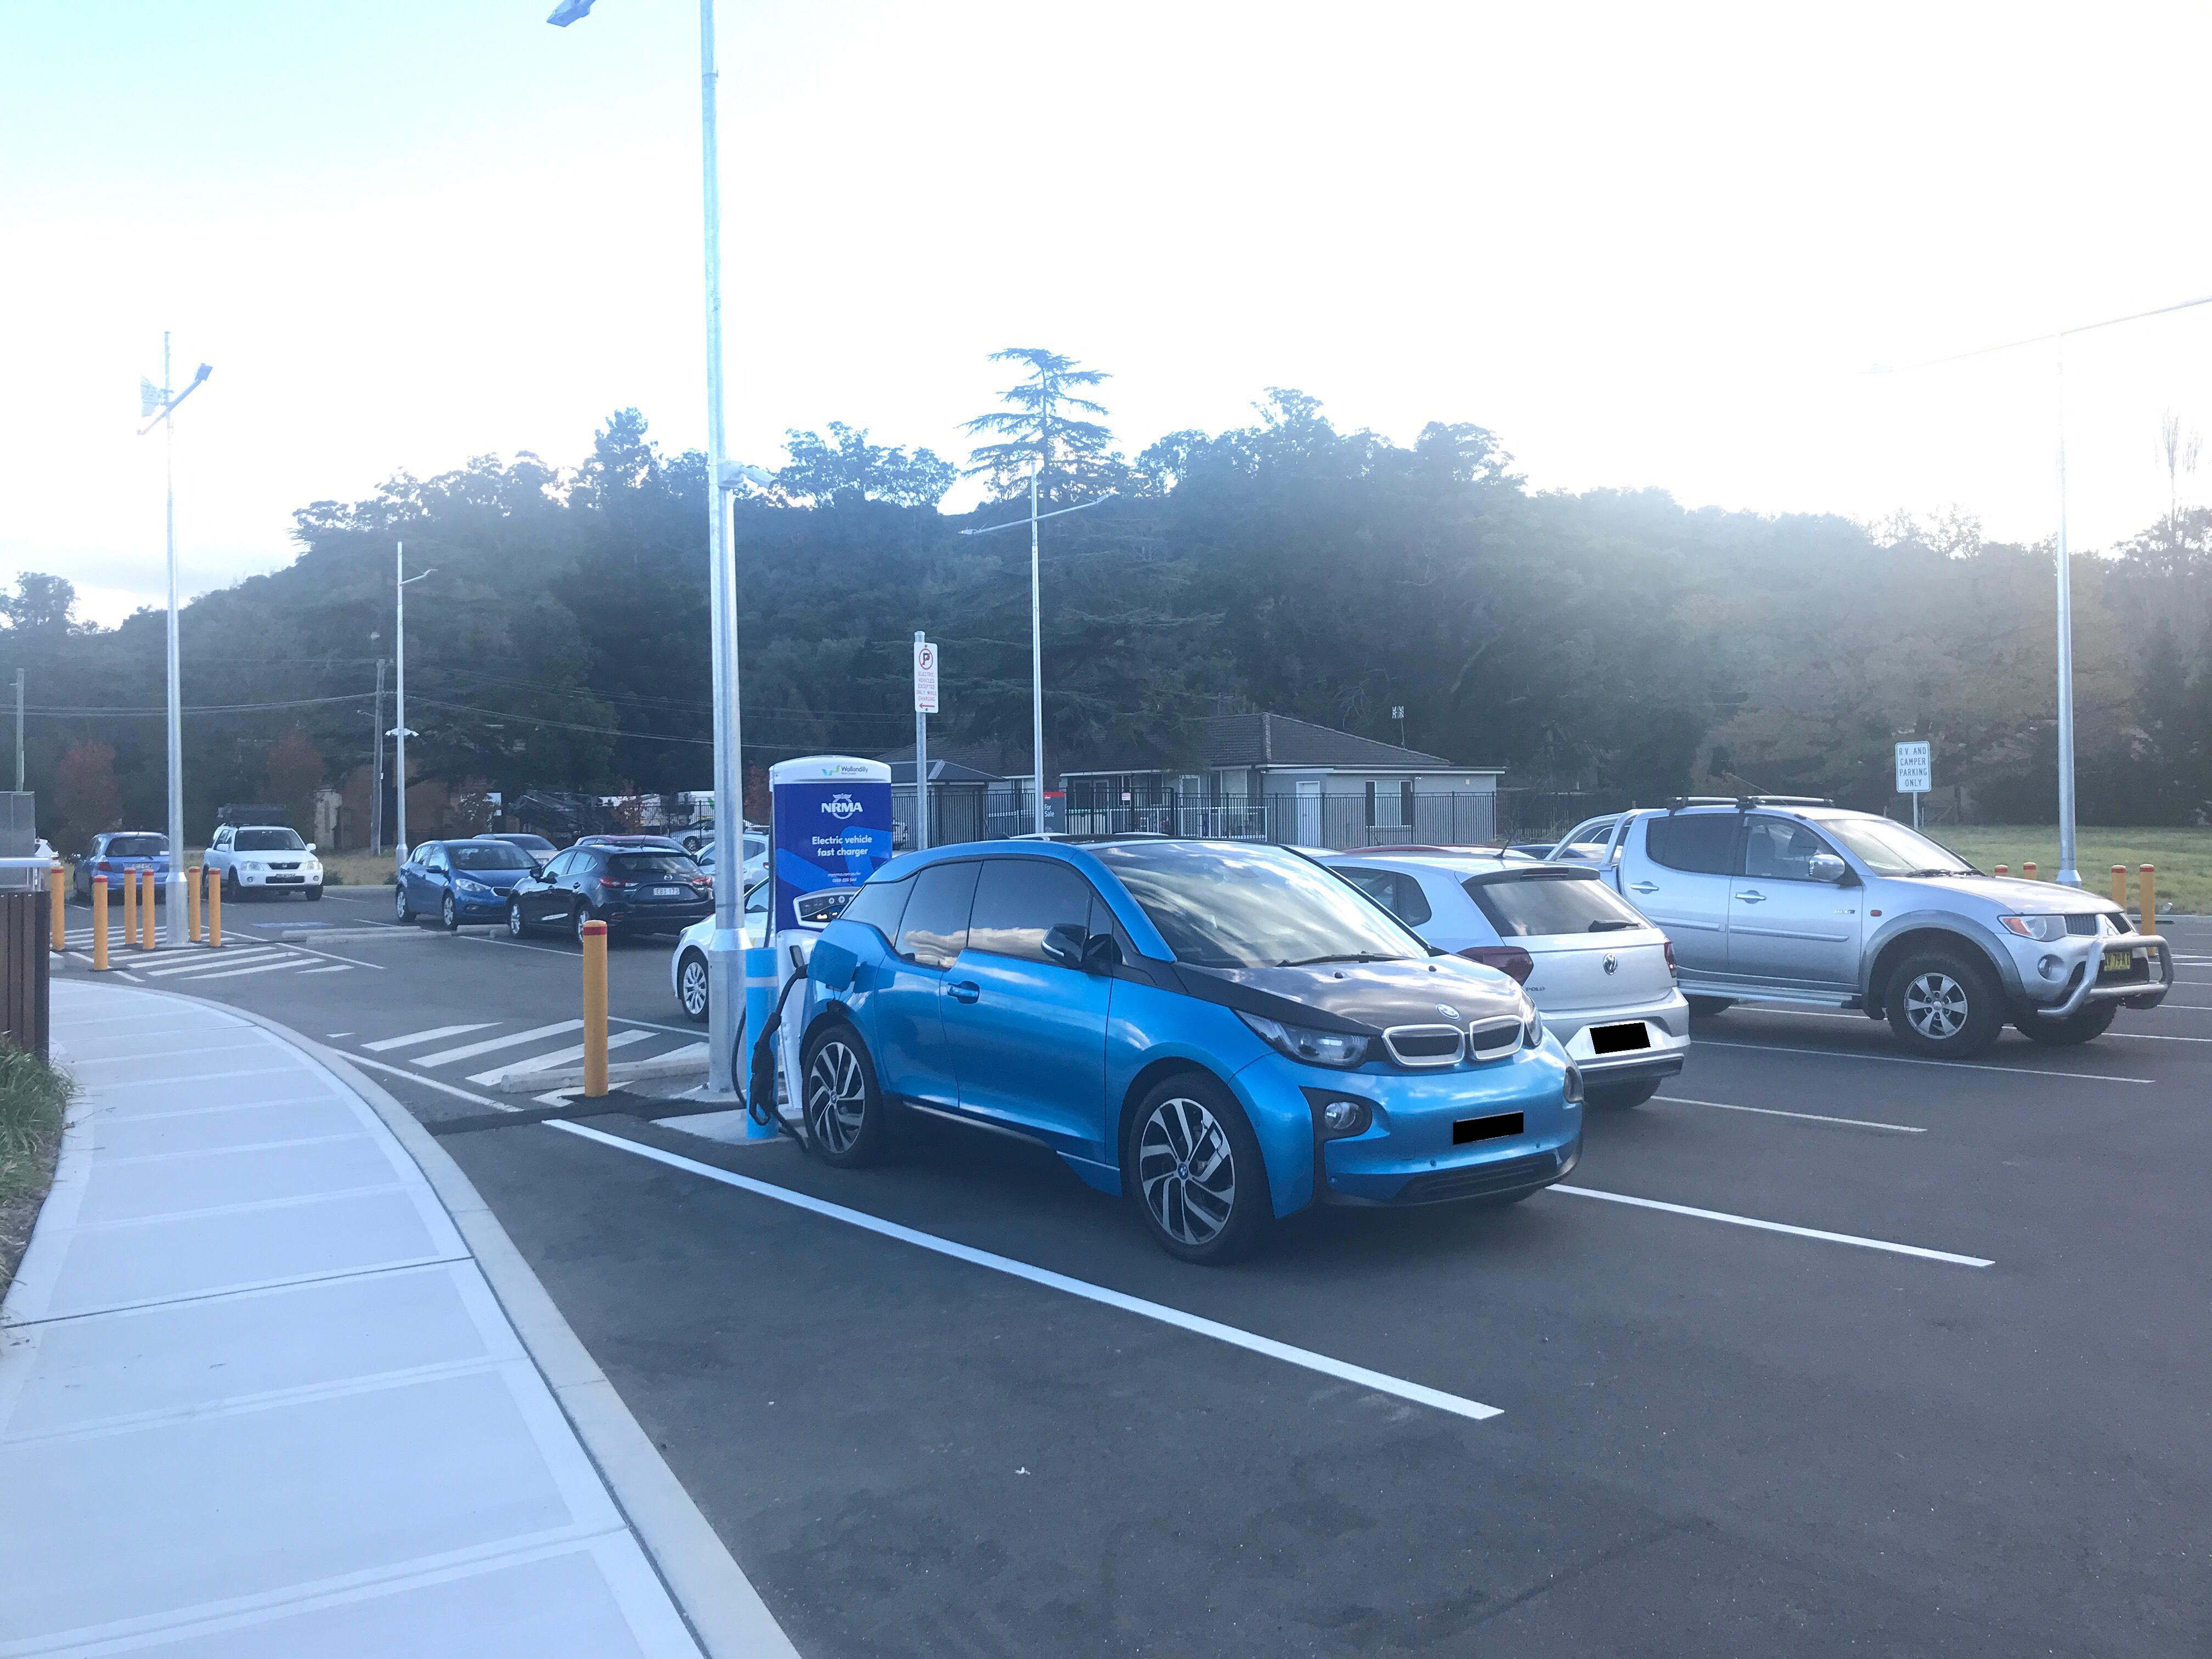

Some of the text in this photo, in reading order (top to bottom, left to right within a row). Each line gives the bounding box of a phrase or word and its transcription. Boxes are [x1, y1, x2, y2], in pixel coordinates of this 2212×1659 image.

[1900, 758, 1926, 766] CAMPER
[1899, 768, 1927, 776] PARKING
[1905, 778, 1922, 787] ONLY
[822, 803, 863, 812] NRMA
[812, 834, 872, 844] Electric vehicle
[837, 848, 868, 857] charger
